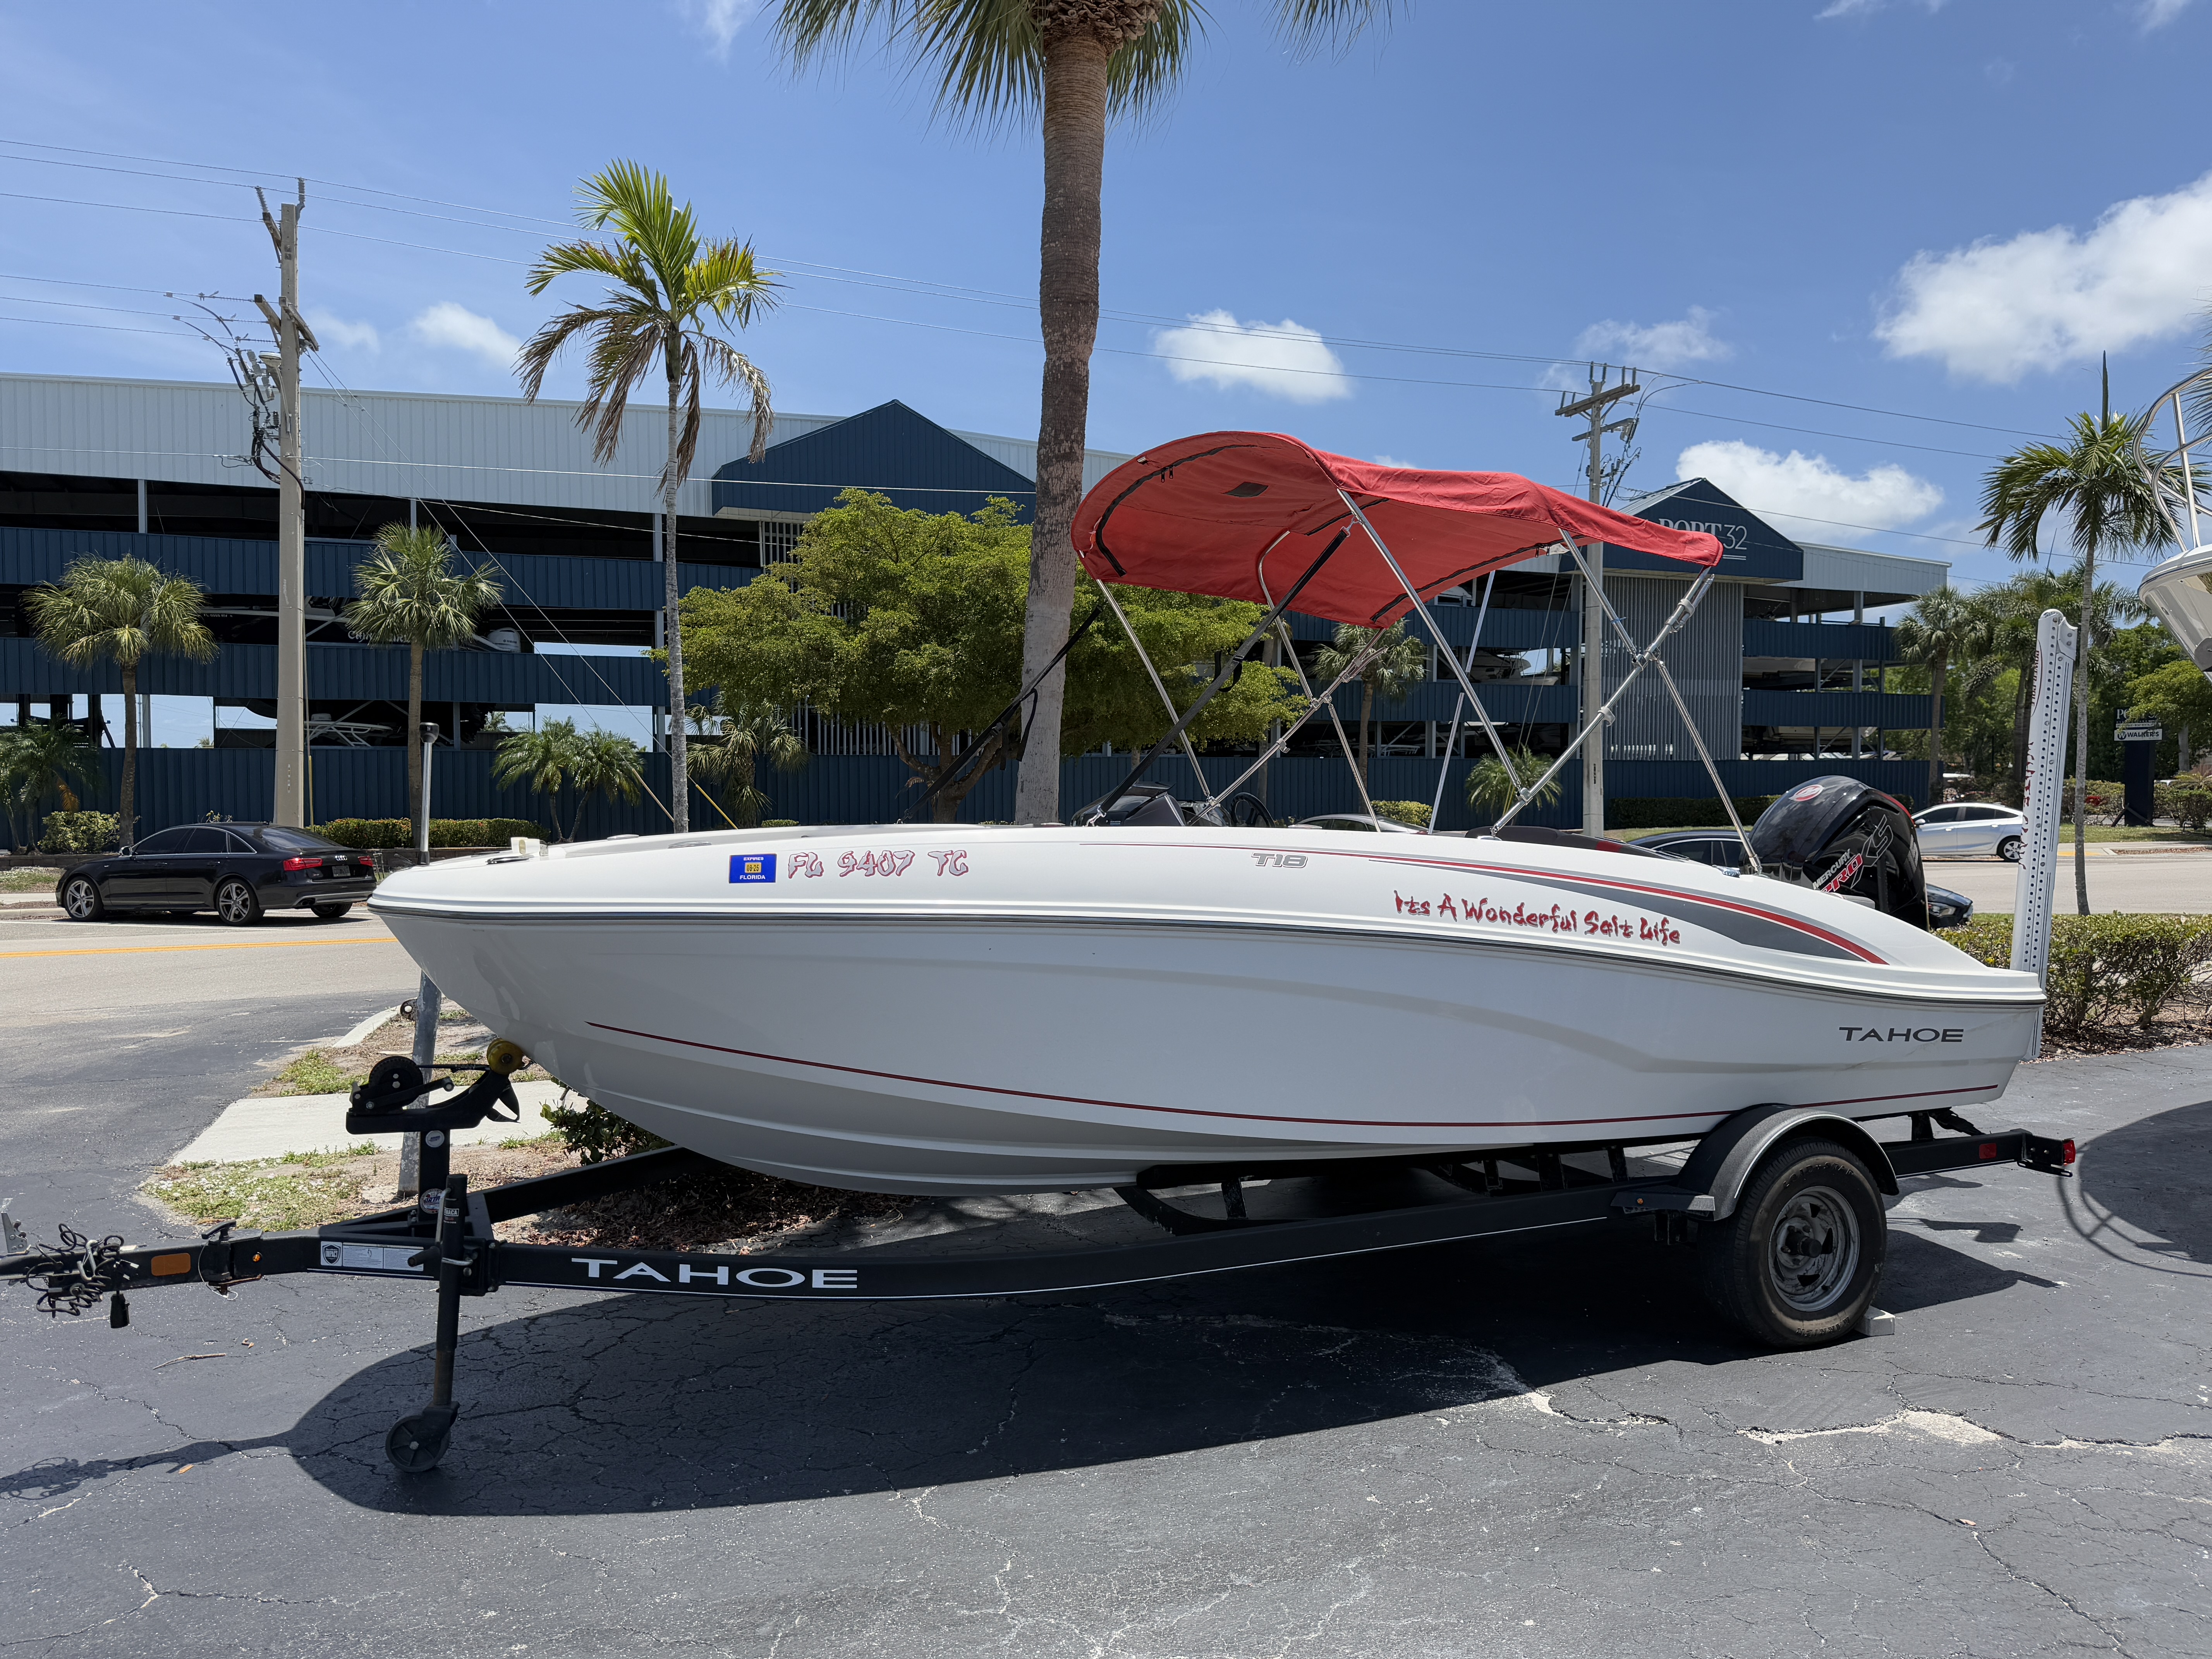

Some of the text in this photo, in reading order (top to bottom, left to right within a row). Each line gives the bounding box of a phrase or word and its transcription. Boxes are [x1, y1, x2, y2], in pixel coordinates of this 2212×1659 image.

[1723, 524, 1747, 550] 32
[788, 850, 969, 878] FL 9407 TC
[1251, 852, 1308, 868] T18
[1812, 848, 1851, 890] MERCURY
[1820, 853, 1863, 893] PRO
[1437, 893, 1457, 922] A
[1461, 897, 1577, 934] Wonderful
[1584, 910, 1633, 939] Salt
[1639, 917, 1680, 946] Life
[1839, 1027, 1964, 1042] TAHOE
[571, 1257, 857, 1289] TAHOE
